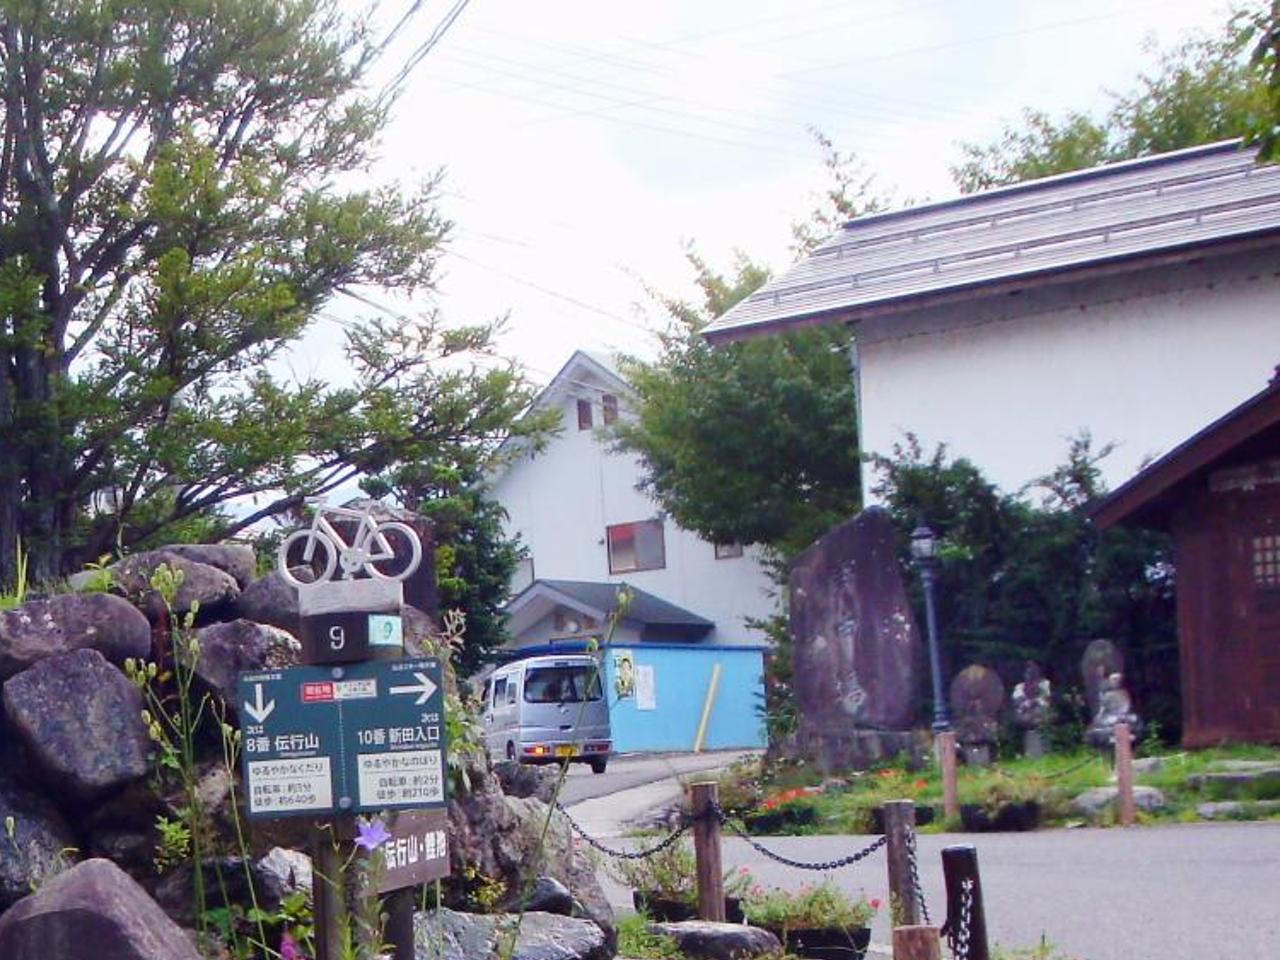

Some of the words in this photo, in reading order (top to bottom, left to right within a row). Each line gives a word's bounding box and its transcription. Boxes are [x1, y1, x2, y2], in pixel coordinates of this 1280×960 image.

[329, 625, 345, 650] 9
[246, 736, 270, 752] 8番
[275, 732, 319, 752] 伝行山
[357, 727, 387, 745] 10番
[389, 726, 440, 744] 新田入口
[384, 828, 447, 871] 伝行山・
